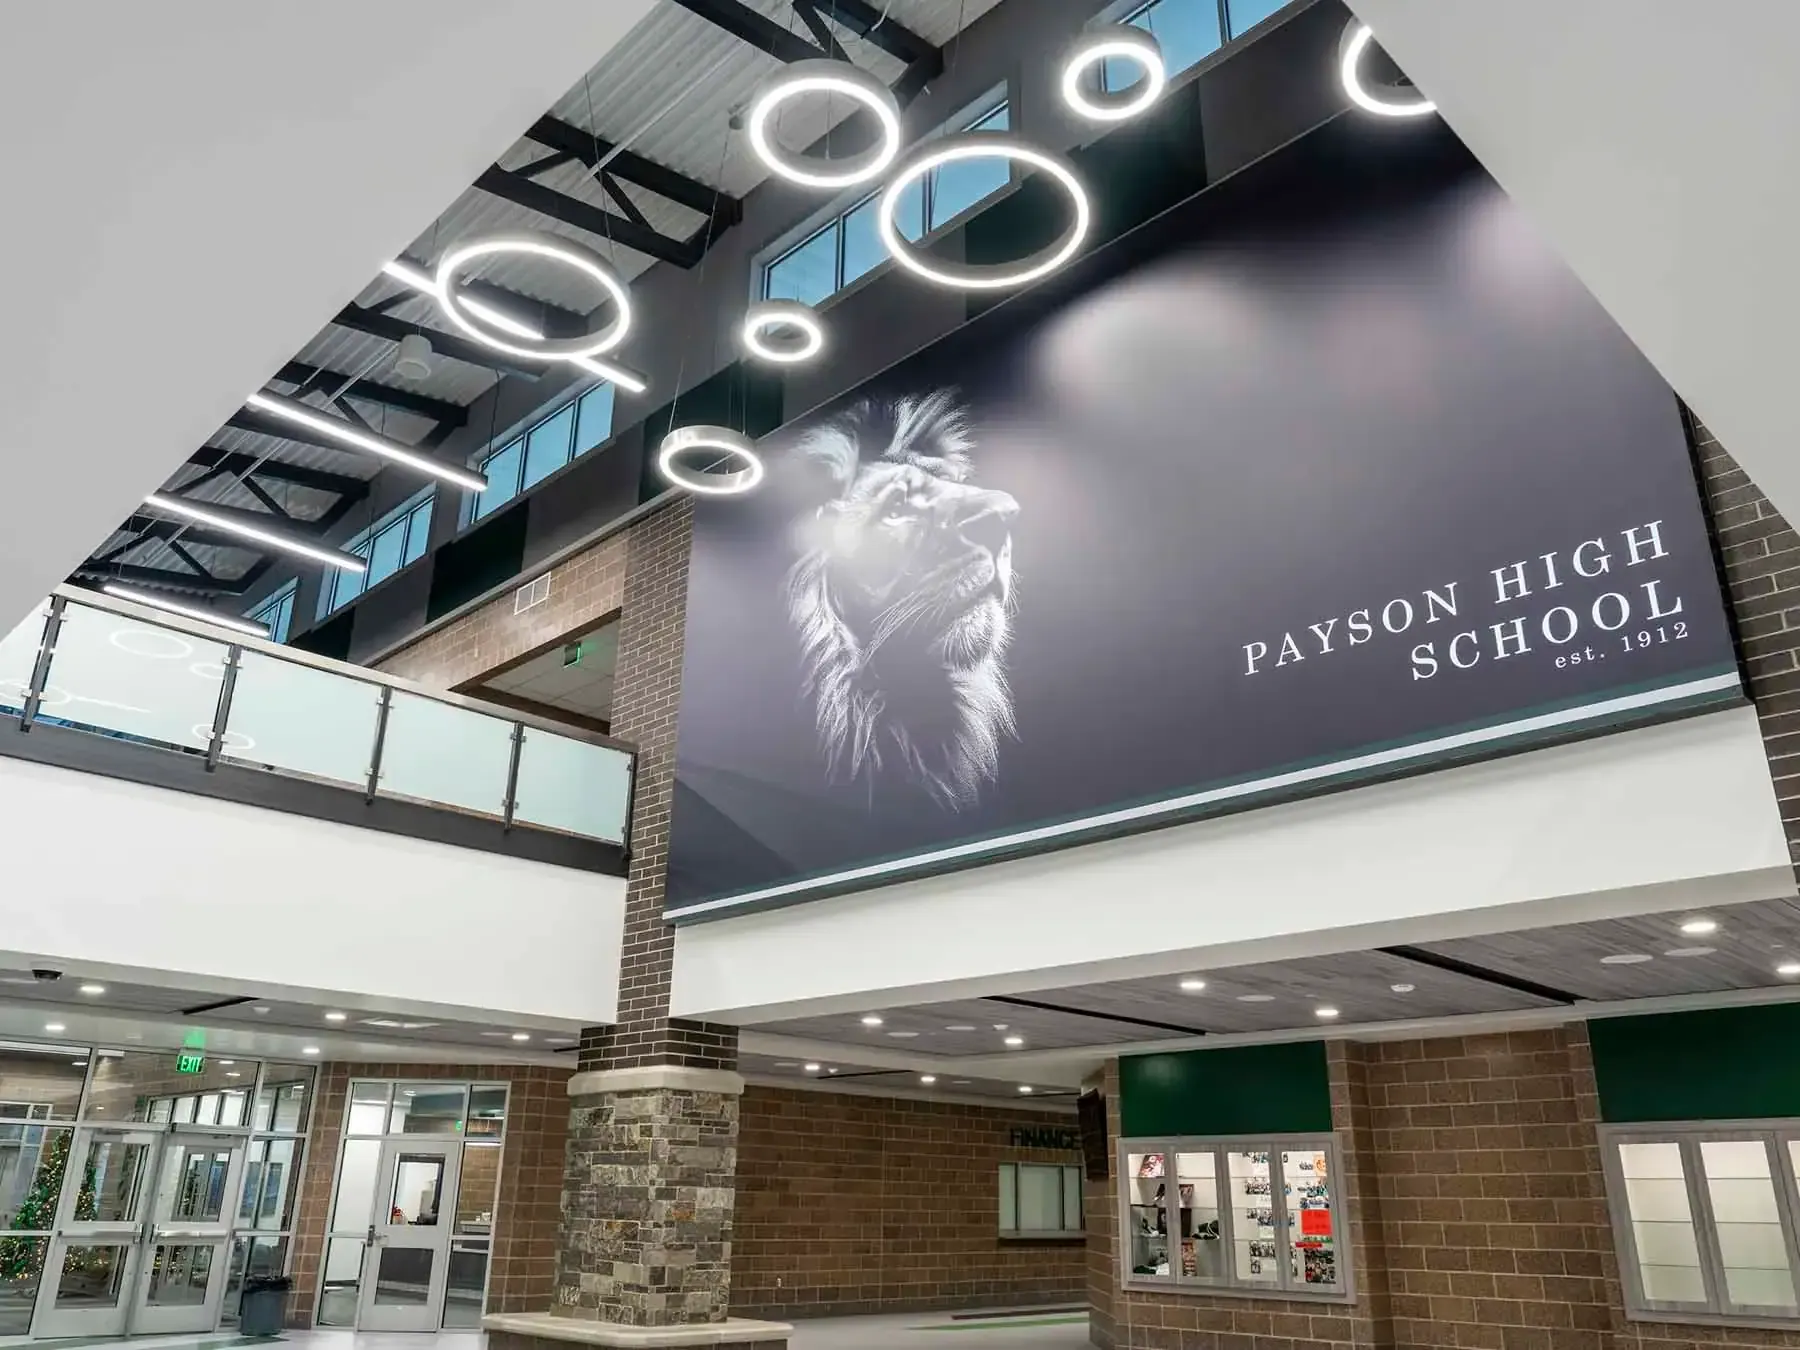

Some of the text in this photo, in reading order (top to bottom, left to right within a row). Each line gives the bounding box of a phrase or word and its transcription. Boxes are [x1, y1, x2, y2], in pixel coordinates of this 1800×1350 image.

[1242, 520, 1669, 675] PAYSON HIGH
[1411, 579, 1683, 681] SCHOOL
[1555, 621, 1688, 669] est. 1912
[180, 1055, 202, 1072] EXIT
